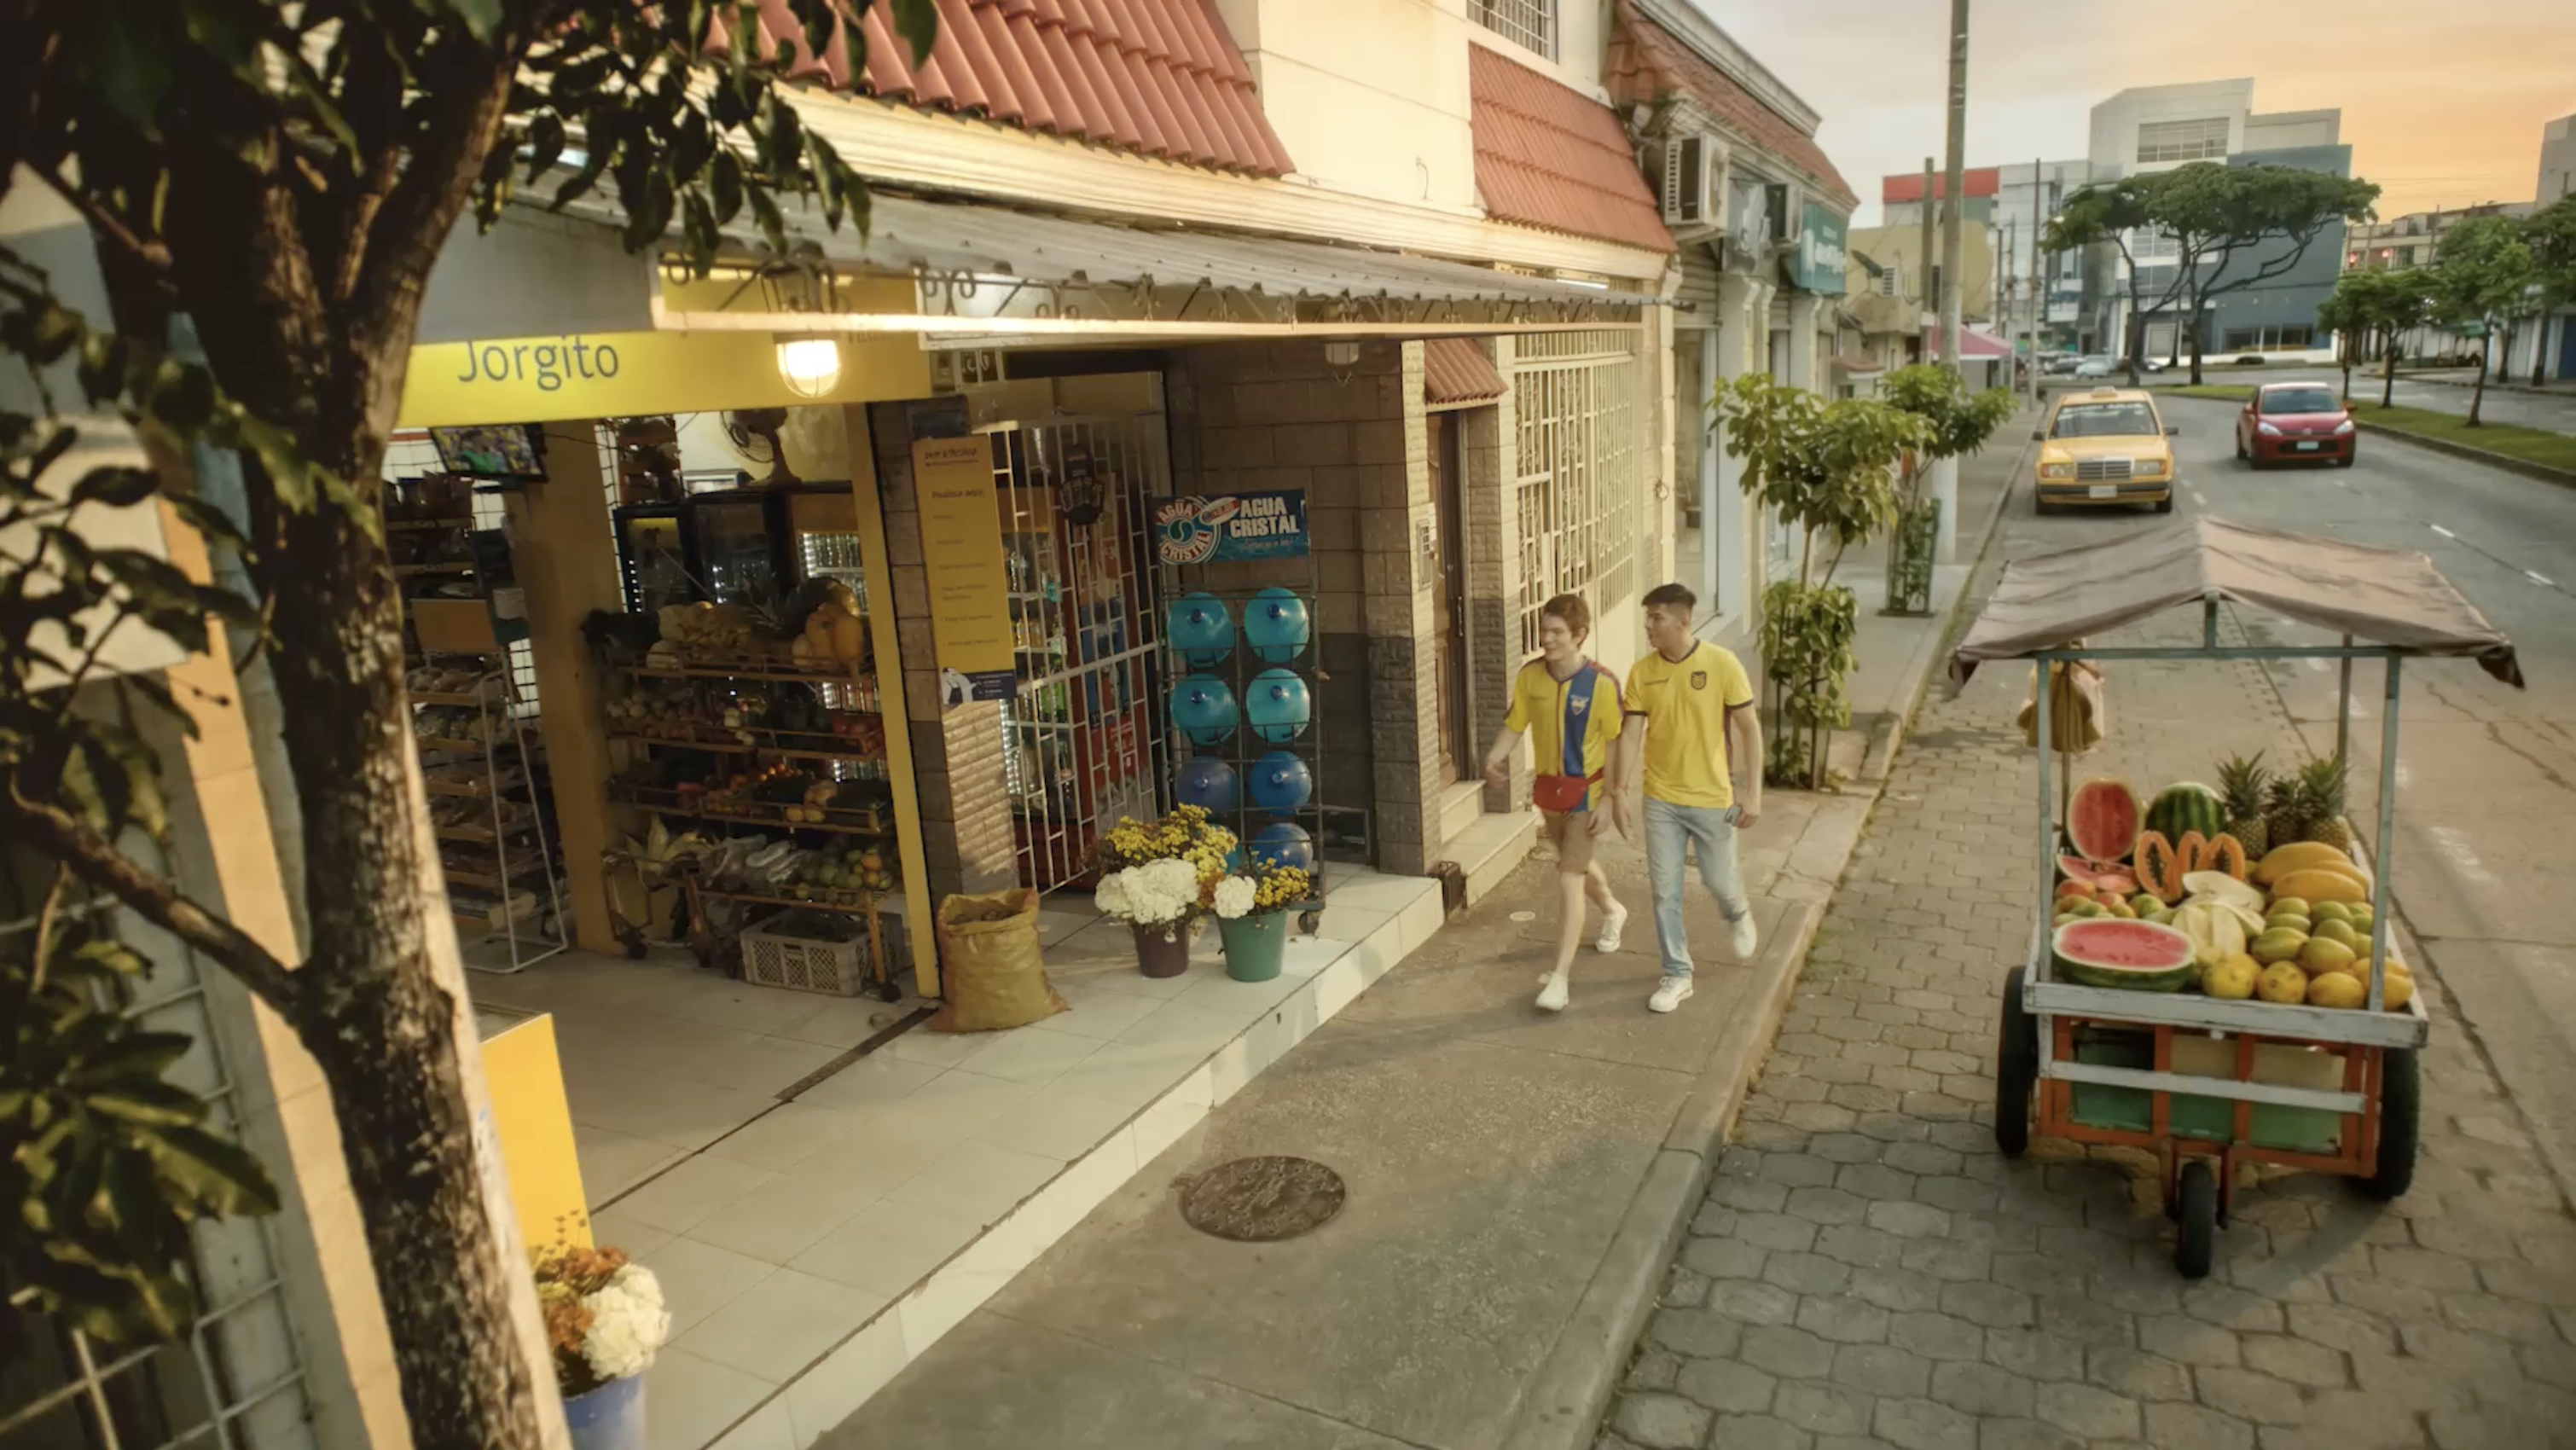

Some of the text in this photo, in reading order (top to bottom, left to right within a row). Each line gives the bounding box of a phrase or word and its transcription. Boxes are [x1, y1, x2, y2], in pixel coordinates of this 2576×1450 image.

[458, 335, 618, 391] Jorgito
[1157, 501, 1193, 524] AGUA
[1240, 496, 1287, 518] AGUA
[1229, 515, 1300, 538] CRISTAL
[1159, 531, 1213, 560] CRISTAL
